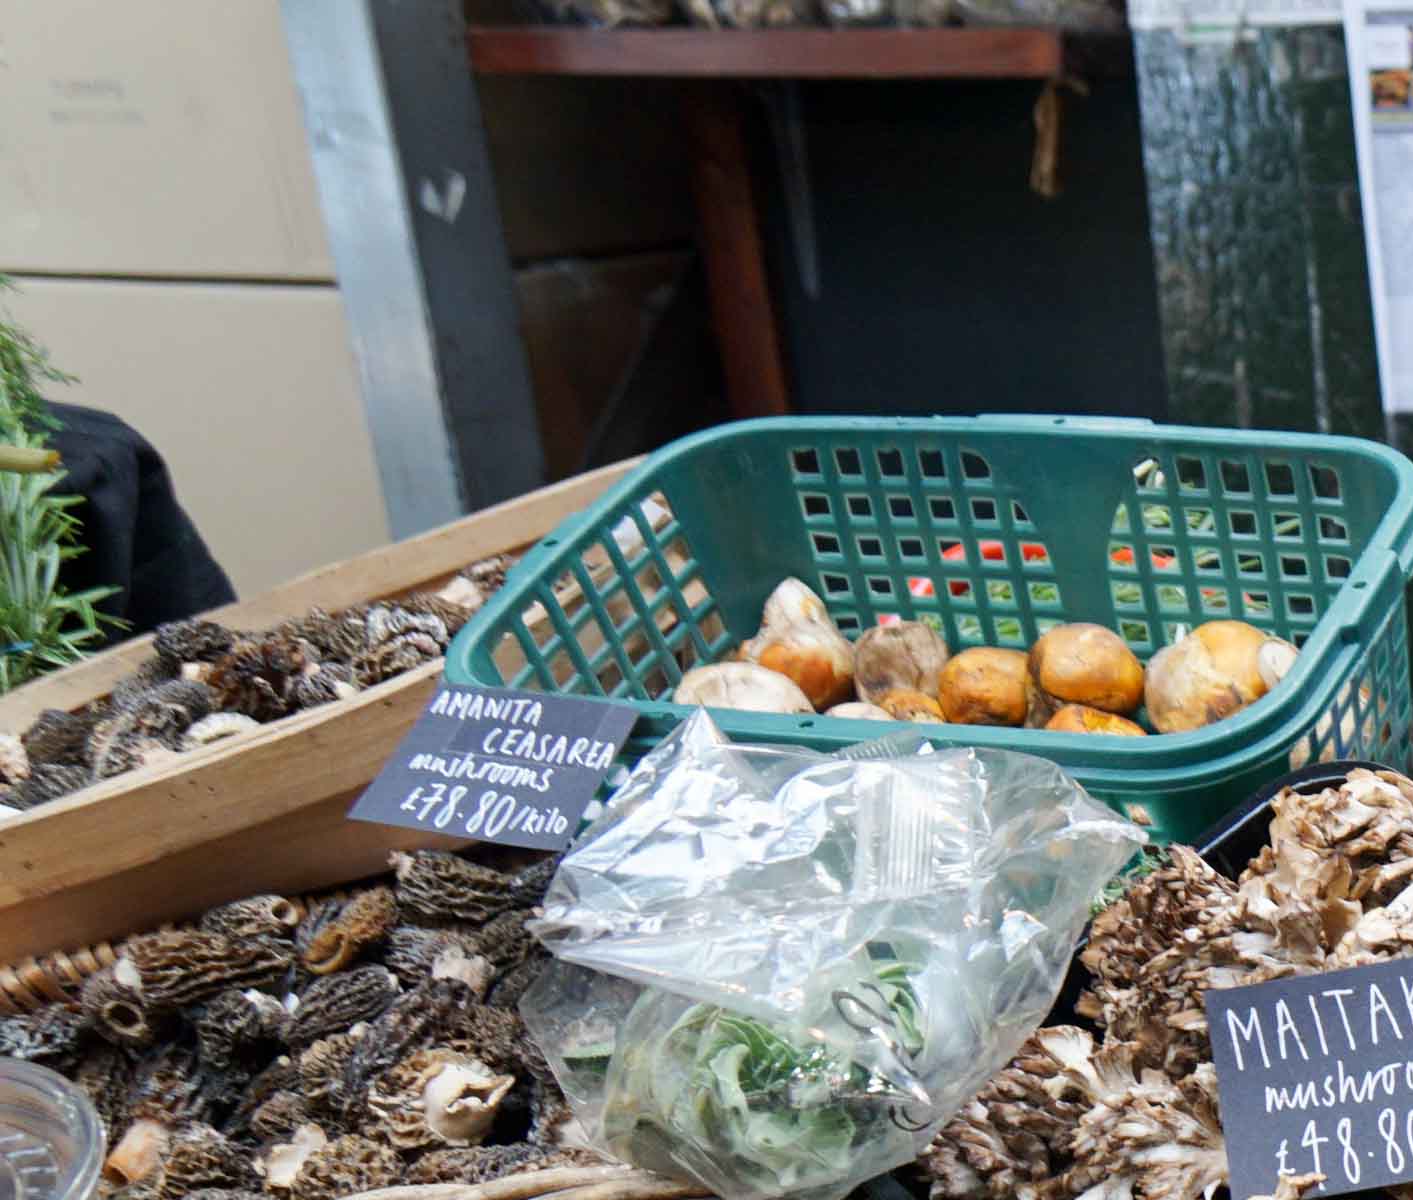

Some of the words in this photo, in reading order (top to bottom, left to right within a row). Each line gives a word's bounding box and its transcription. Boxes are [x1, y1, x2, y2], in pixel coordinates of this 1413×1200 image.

[430, 690, 542, 727] AMANITA
[482, 727, 617, 771] CEASAREA
[408, 751, 555, 793] mushrooms
[400, 782, 569, 838] £78.80/kilo
